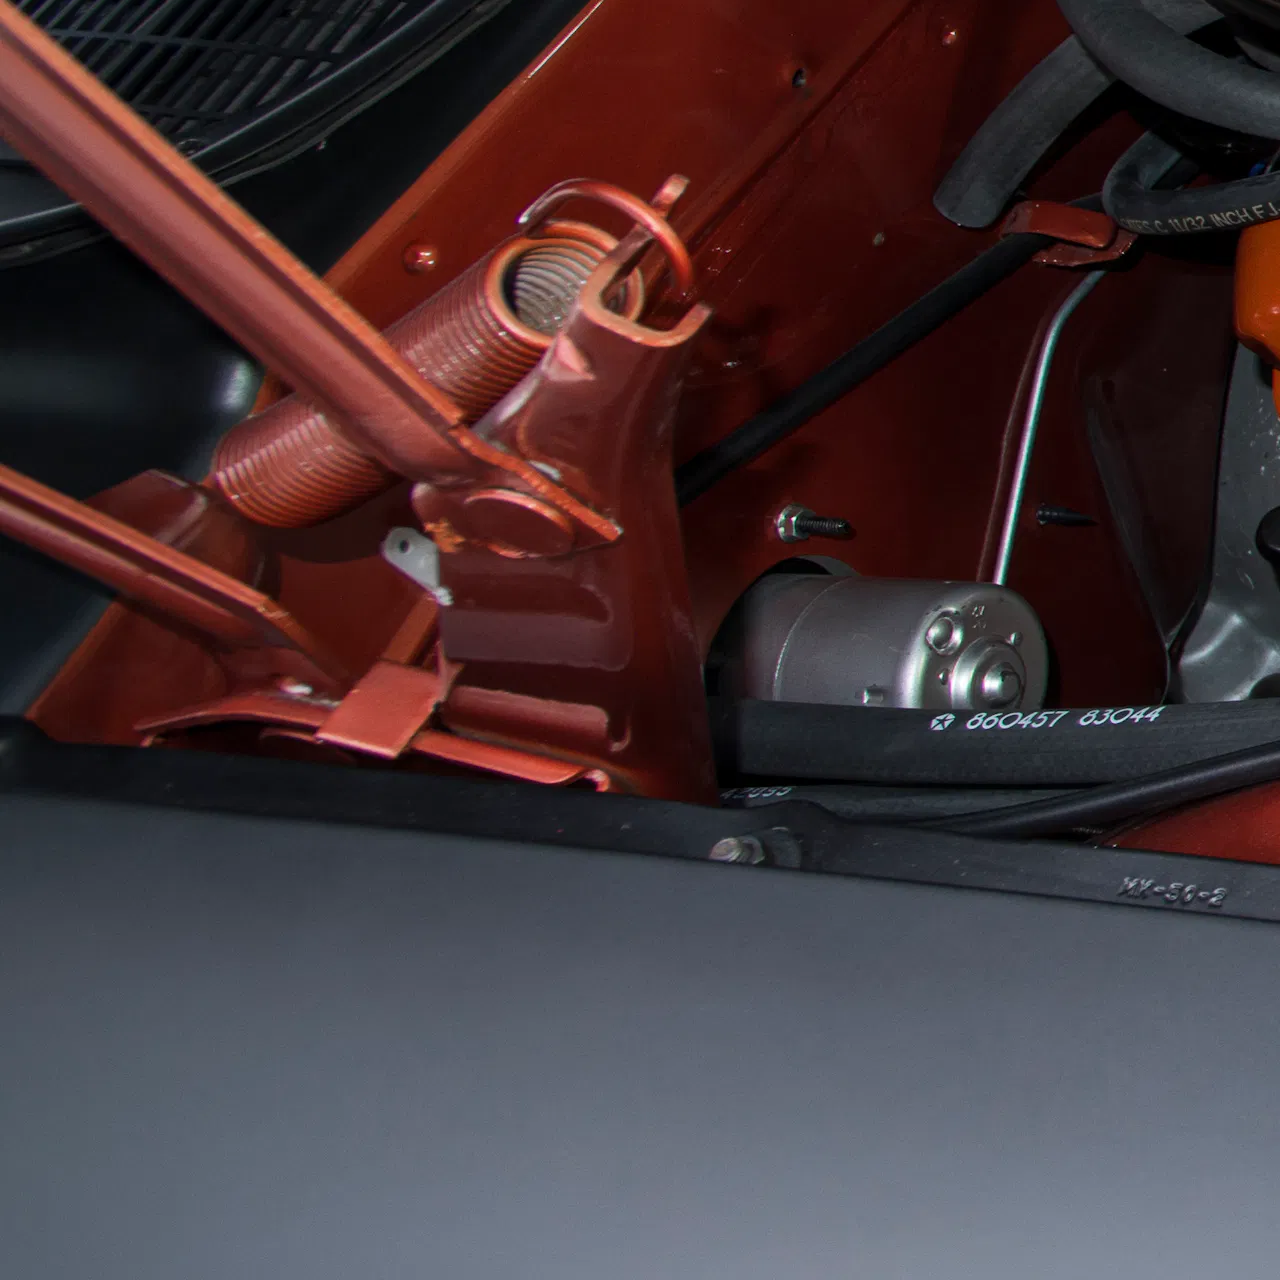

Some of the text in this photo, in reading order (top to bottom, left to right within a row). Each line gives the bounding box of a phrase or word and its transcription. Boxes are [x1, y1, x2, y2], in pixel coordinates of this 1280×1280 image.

[1208, 206, 1250, 229] INCH
[965, 705, 1166, 731] 860457 83044
